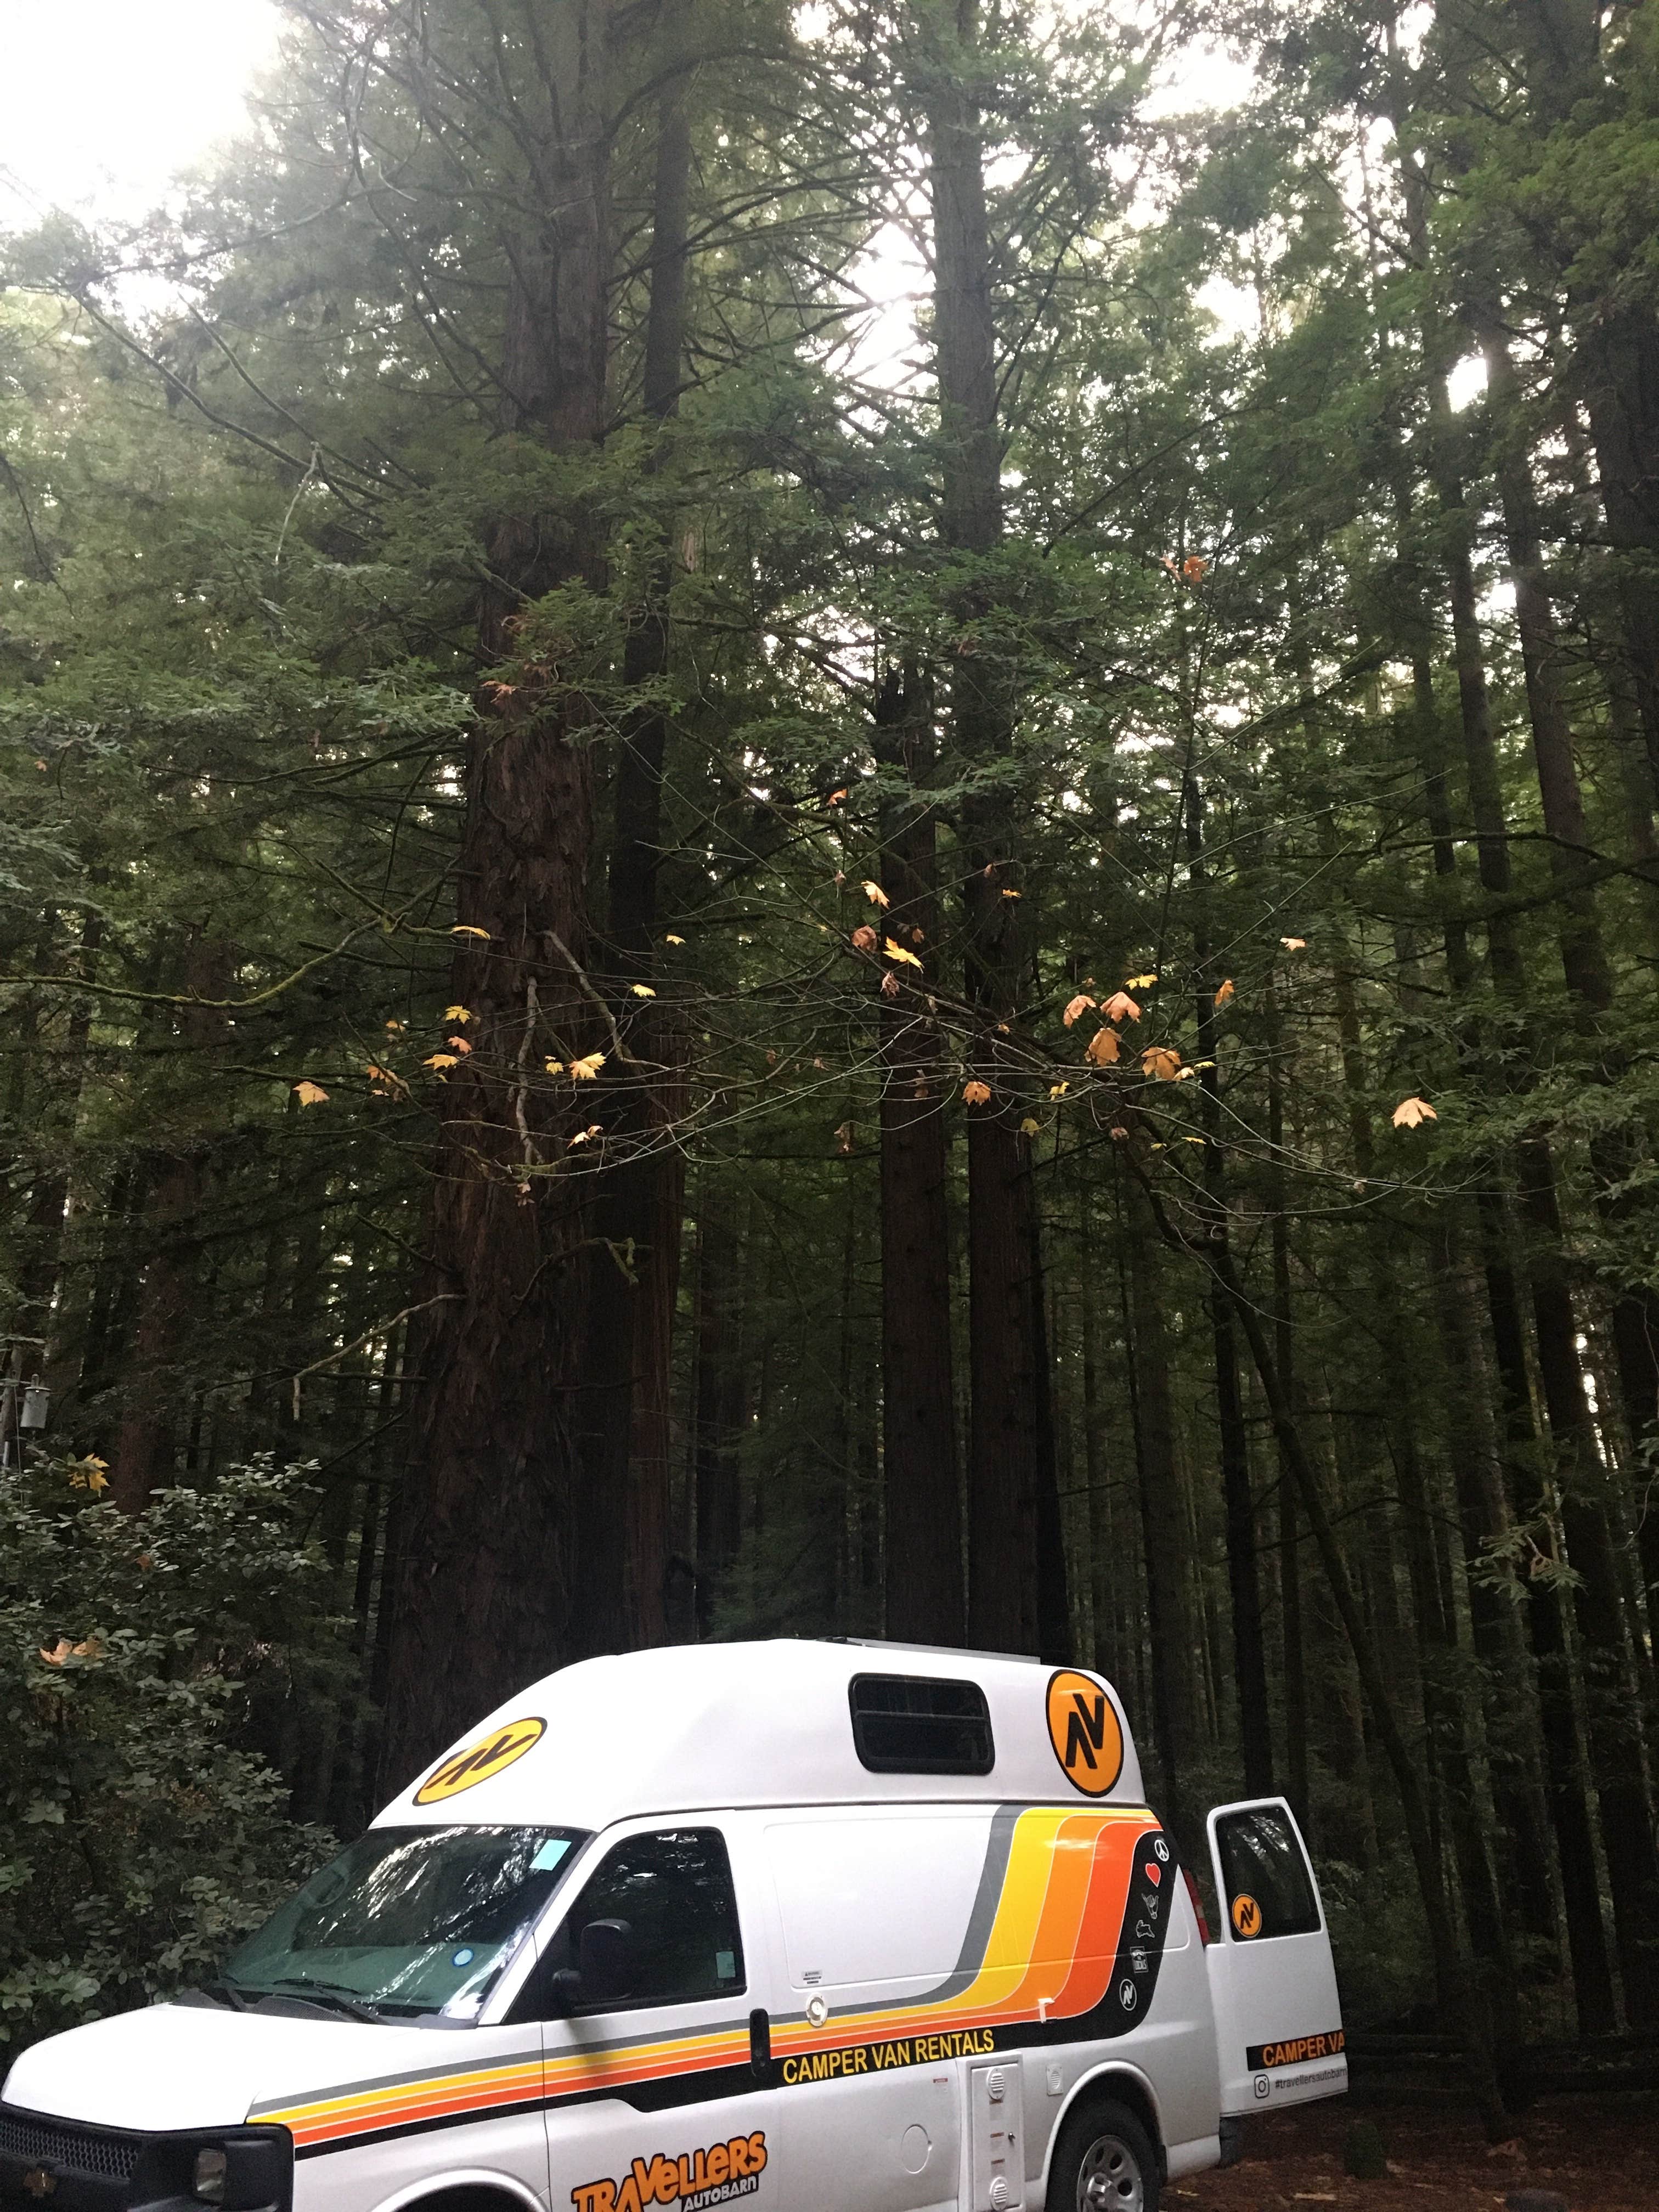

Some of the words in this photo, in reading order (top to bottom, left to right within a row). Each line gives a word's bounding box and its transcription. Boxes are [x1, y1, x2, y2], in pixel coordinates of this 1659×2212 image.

[782, 2047, 868, 2084] CAMPER
[872, 2041, 910, 2069] VAN
[915, 2029, 995, 2062] RENTALS
[1262, 2035, 1327, 2067] CAMPER
